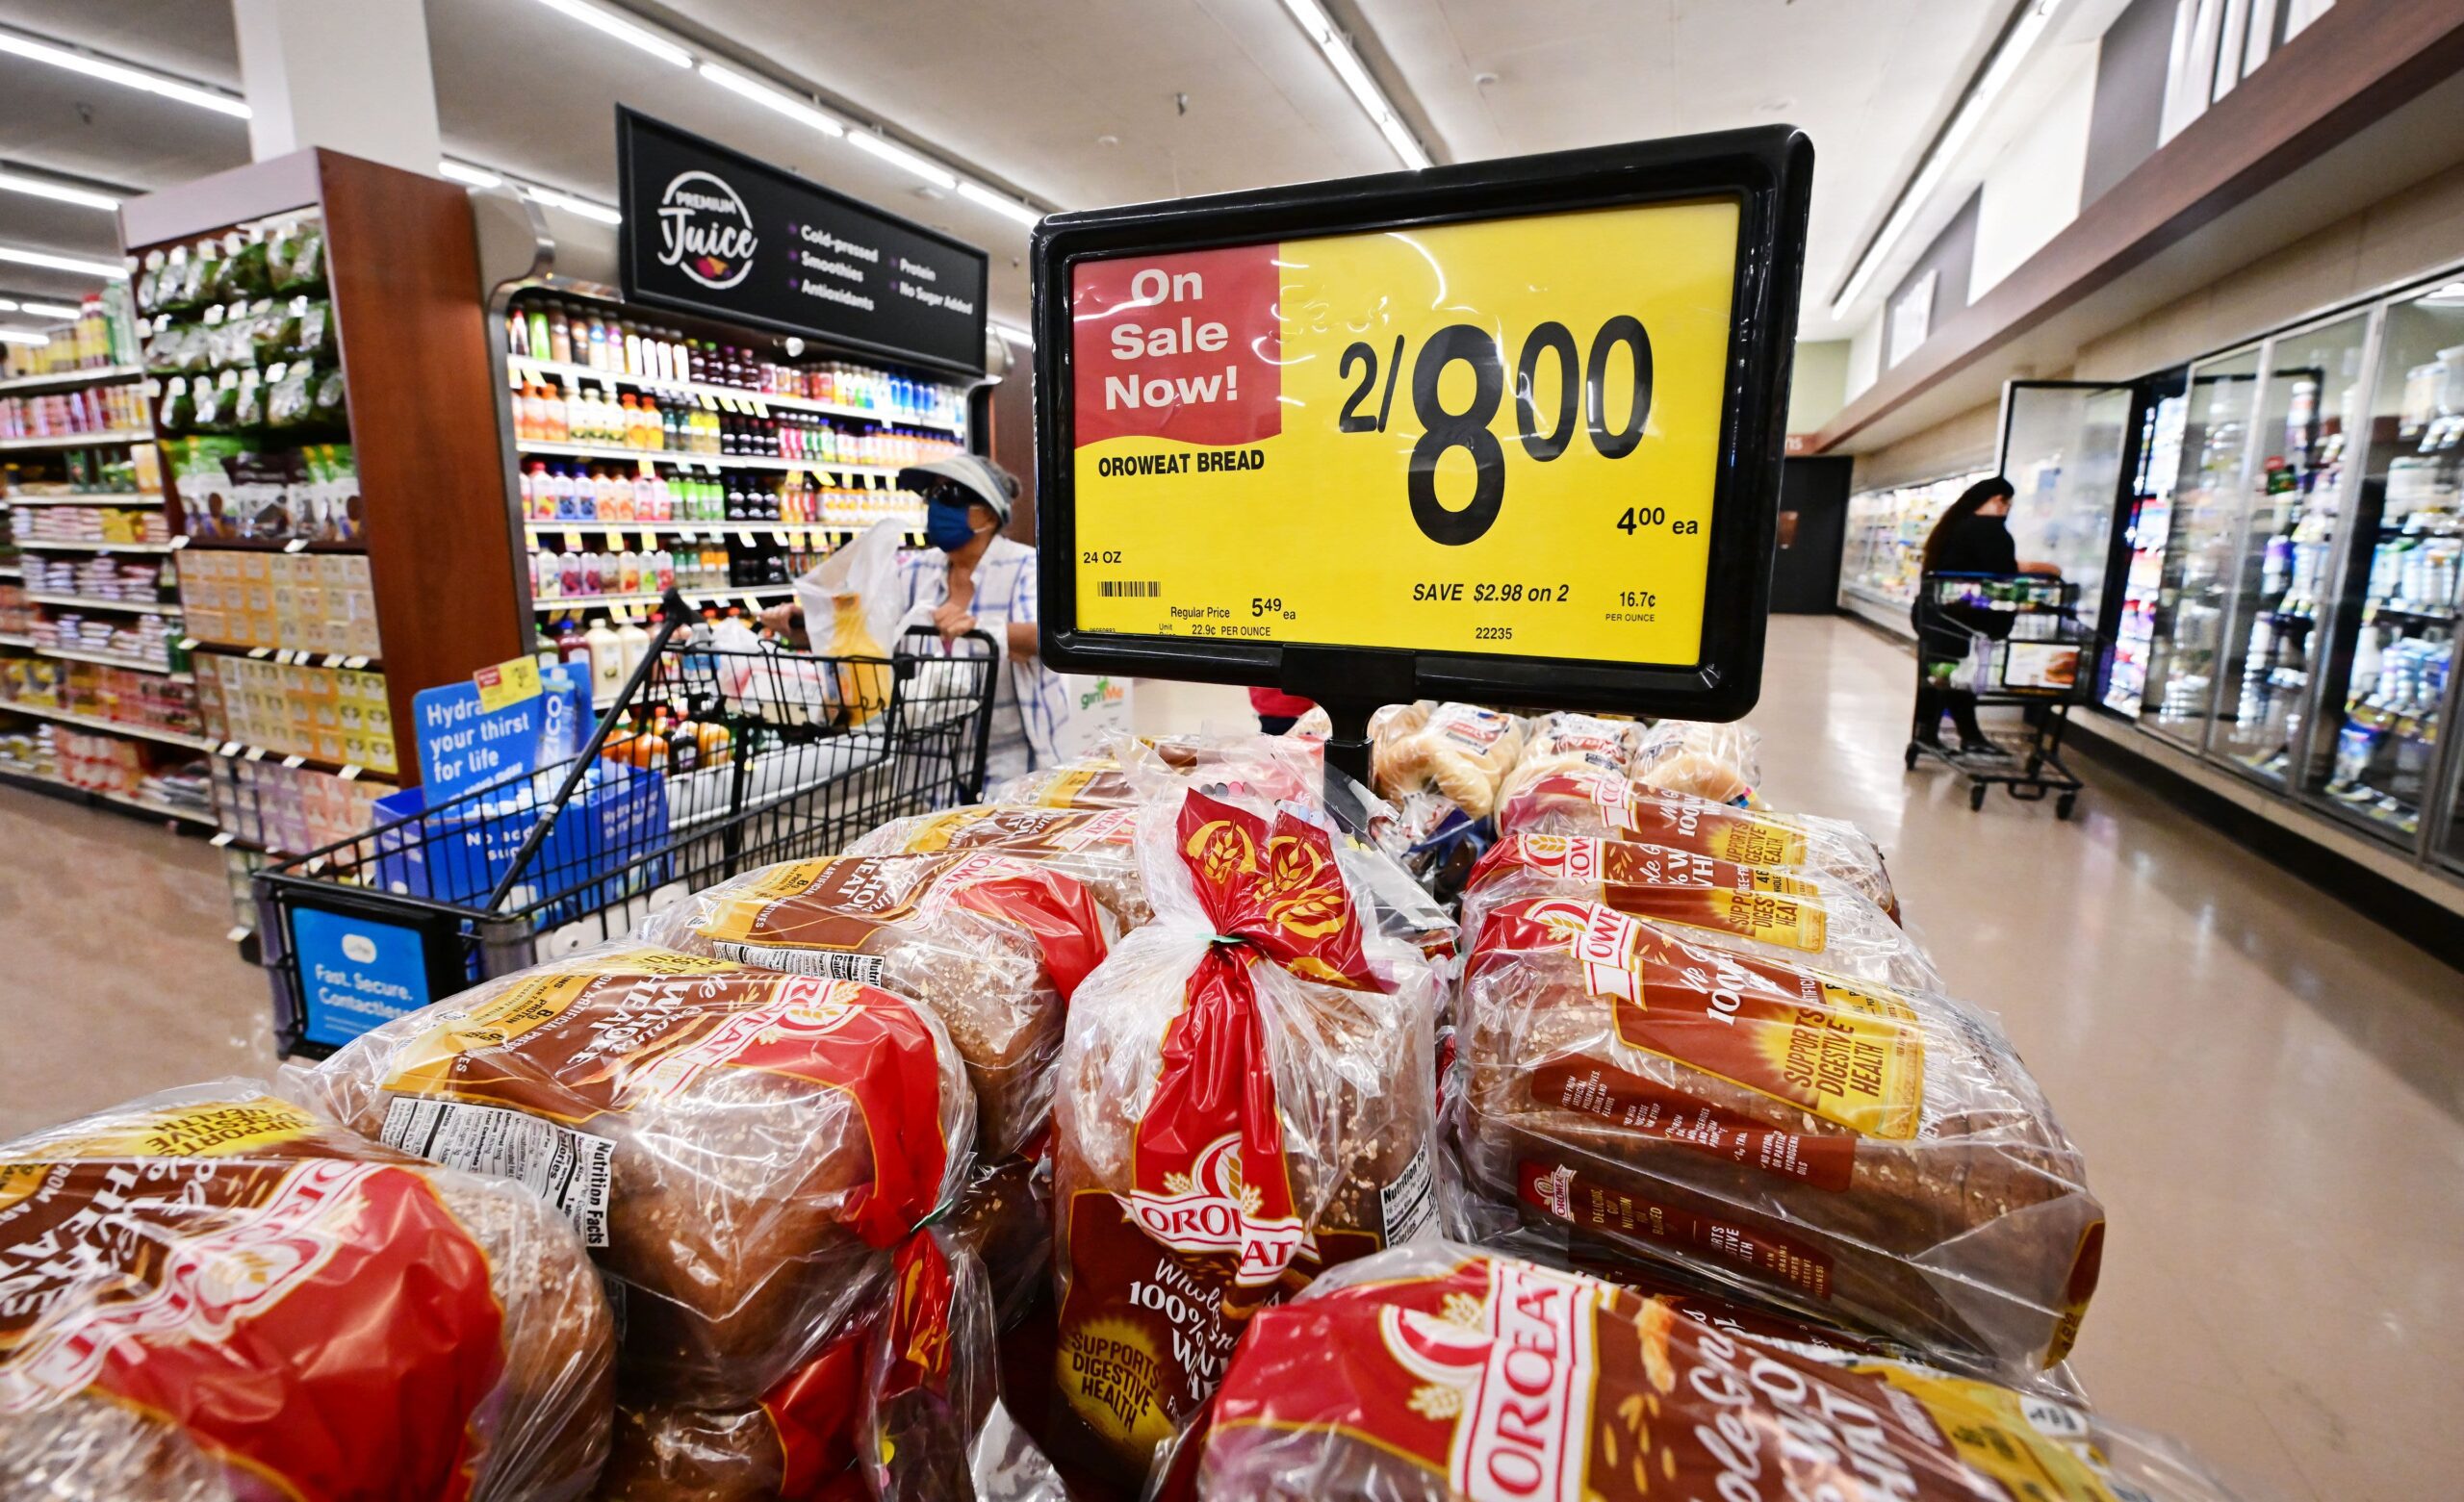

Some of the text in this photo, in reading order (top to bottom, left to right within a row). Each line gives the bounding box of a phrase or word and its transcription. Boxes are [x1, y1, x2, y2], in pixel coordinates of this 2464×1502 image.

[676, 191, 736, 215] PREMIUM
[657, 207, 757, 266] Juice
[801, 224, 879, 263] Cold-pressed
[801, 250, 863, 282] Smoothies
[900, 258, 936, 281] Protein
[801, 279, 874, 311] Antioxidants
[900, 281, 973, 315] No Sugar Added
[1131, 268, 1203, 305] On
[1111, 318, 1229, 361] Sale
[1104, 366, 1239, 411] Now!
[1098, 449, 1265, 477] OROWEAT BREAD
[1672, 521, 1699, 535] ea
[1083, 551, 1122, 565] 24 OZ
[1412, 583, 1570, 603] SAVE $2.98 on 2
[1159, 623, 1172, 632] Unit
[1220, 625, 1239, 636] PER
[1241, 626, 1270, 637] OUNCE
[1170, 606, 1204, 620] Regular
[1207, 606, 1230, 618] Price
[1283, 610, 1296, 620] ea
[1605, 613, 1655, 623] PER OUNCE
[1476, 627, 1513, 640] 22235
[430, 713, 529, 759] your thirst
[434, 759, 463, 783] for
[469, 749, 499, 774] life
[315, 963, 414, 1001] Fast. Secure.
[505, 998, 549, 1026] PROTEIN
[1784, 1006, 1826, 1089] SUPPORTS
[1815, 1017, 1855, 1098] DIGESTIVE
[1849, 1041, 1884, 1097] HEALTH
[586, 1141, 613, 1244] Nutrition Facts
[1383, 1162, 1418, 1206] Nutrition
[1141, 1204, 1298, 1269] OROAT
[1128, 1280, 1207, 1347] 100%
[1070, 1333, 1162, 1392] SUPPORTS
[1072, 1355, 1153, 1417] DIGESTIVE
[1081, 1375, 1140, 1434] HEALTH
